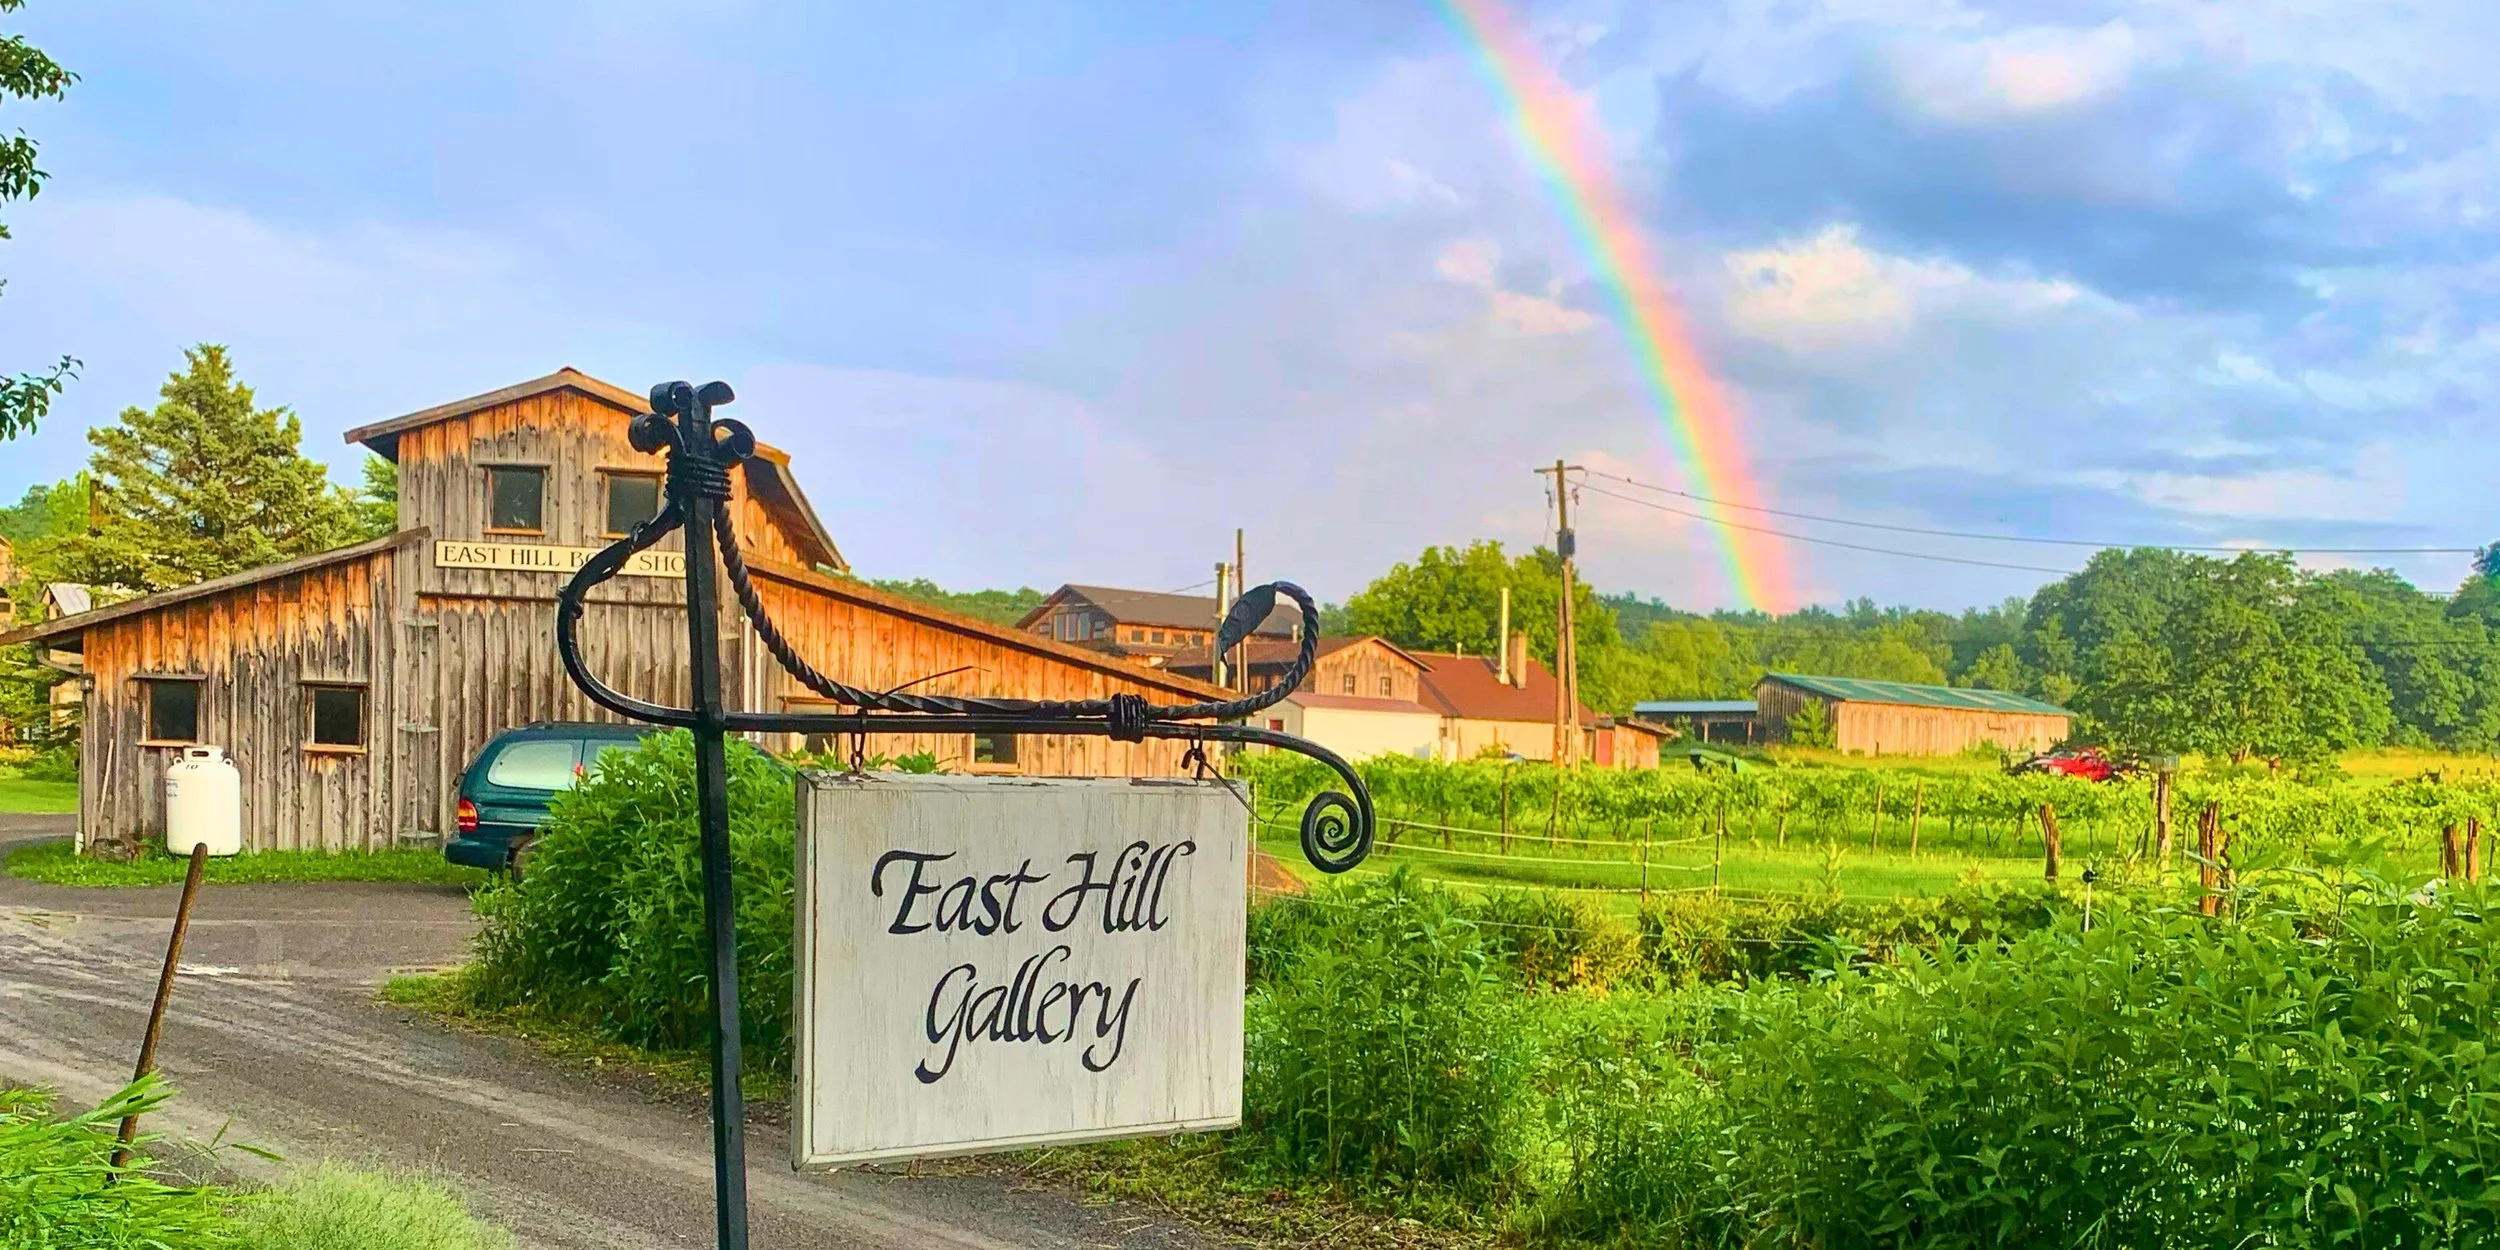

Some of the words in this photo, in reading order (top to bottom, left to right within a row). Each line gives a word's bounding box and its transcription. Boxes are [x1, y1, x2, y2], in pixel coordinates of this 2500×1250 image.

[444, 545, 501, 563] EAST
[511, 548, 560, 566] HILL
[639, 555, 686, 572] SHO
[871, 849, 1051, 936] East
[1042, 840, 1196, 934] Hill
[914, 944, 1142, 1084] Gallery
